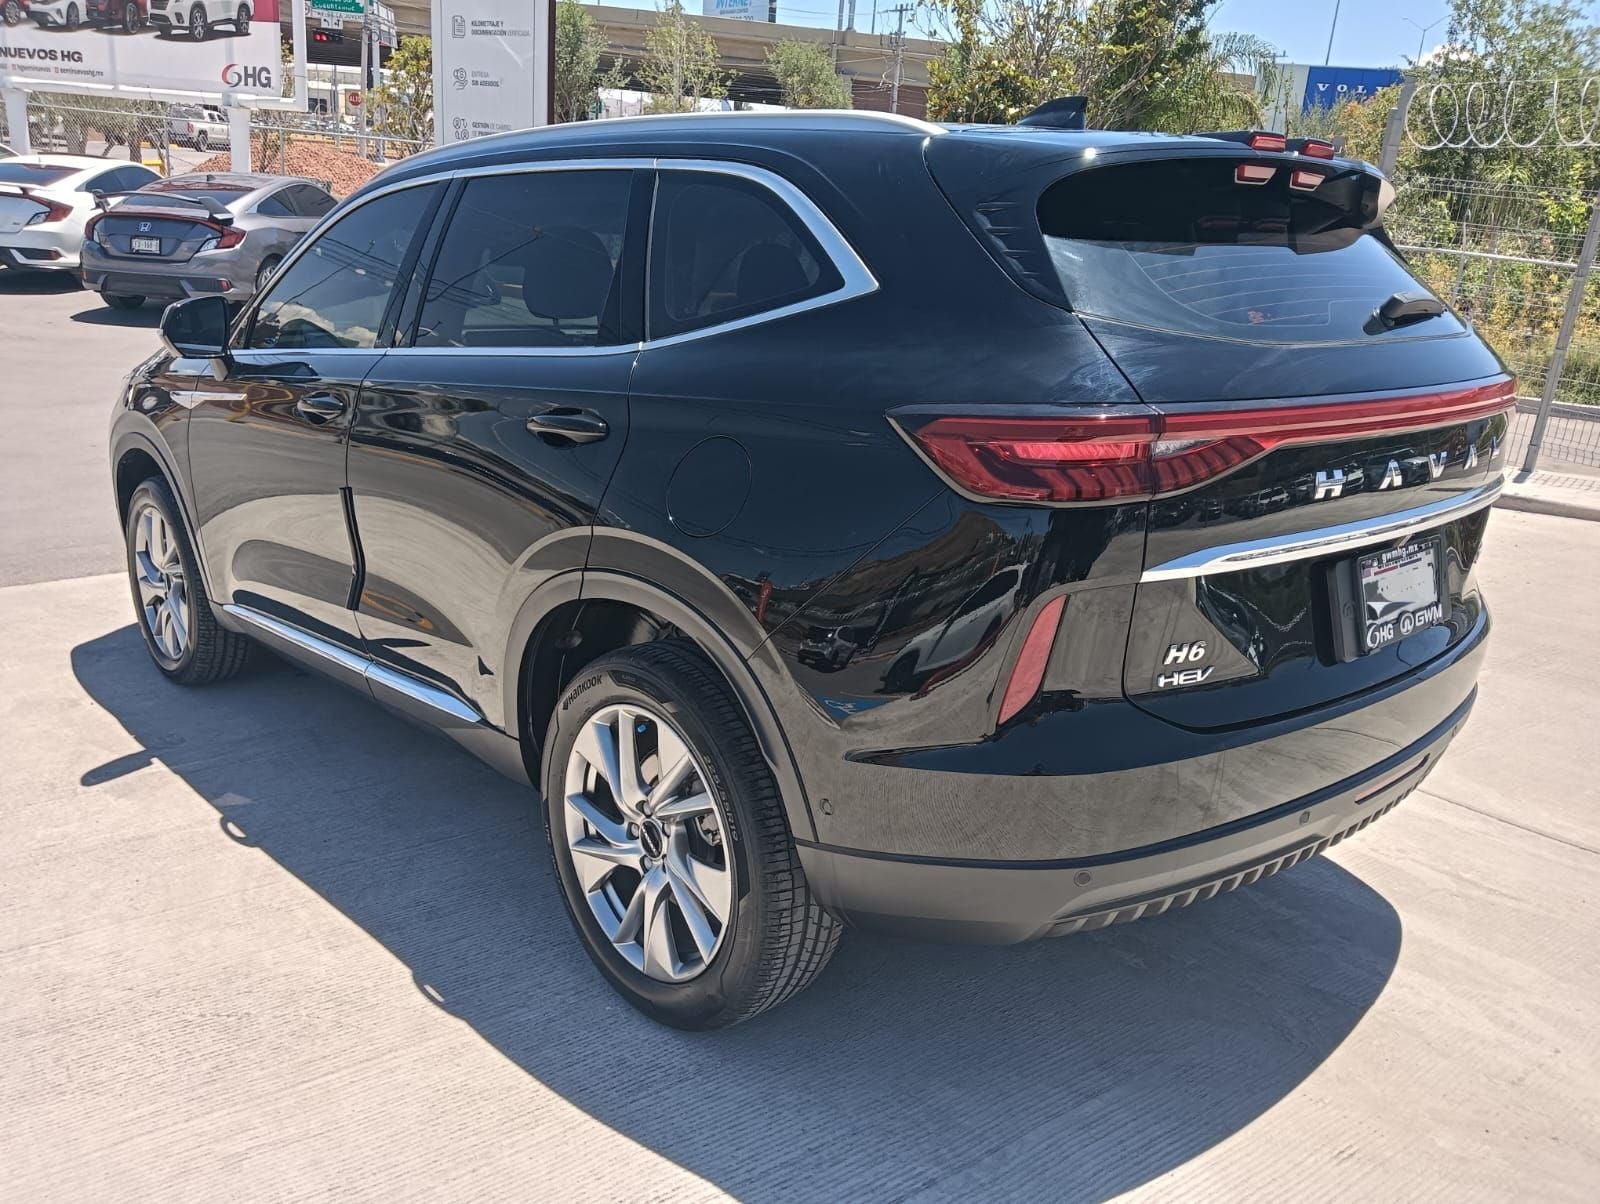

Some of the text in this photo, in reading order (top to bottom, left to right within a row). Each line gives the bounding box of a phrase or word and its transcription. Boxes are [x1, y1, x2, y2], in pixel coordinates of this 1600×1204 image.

[60, 50, 83, 63] HG
[243, 66, 272, 89] HG
[1380, 603, 1443, 643] HG GWM
[1163, 640, 1207, 665] H6
[1157, 665, 1215, 688] HEV
